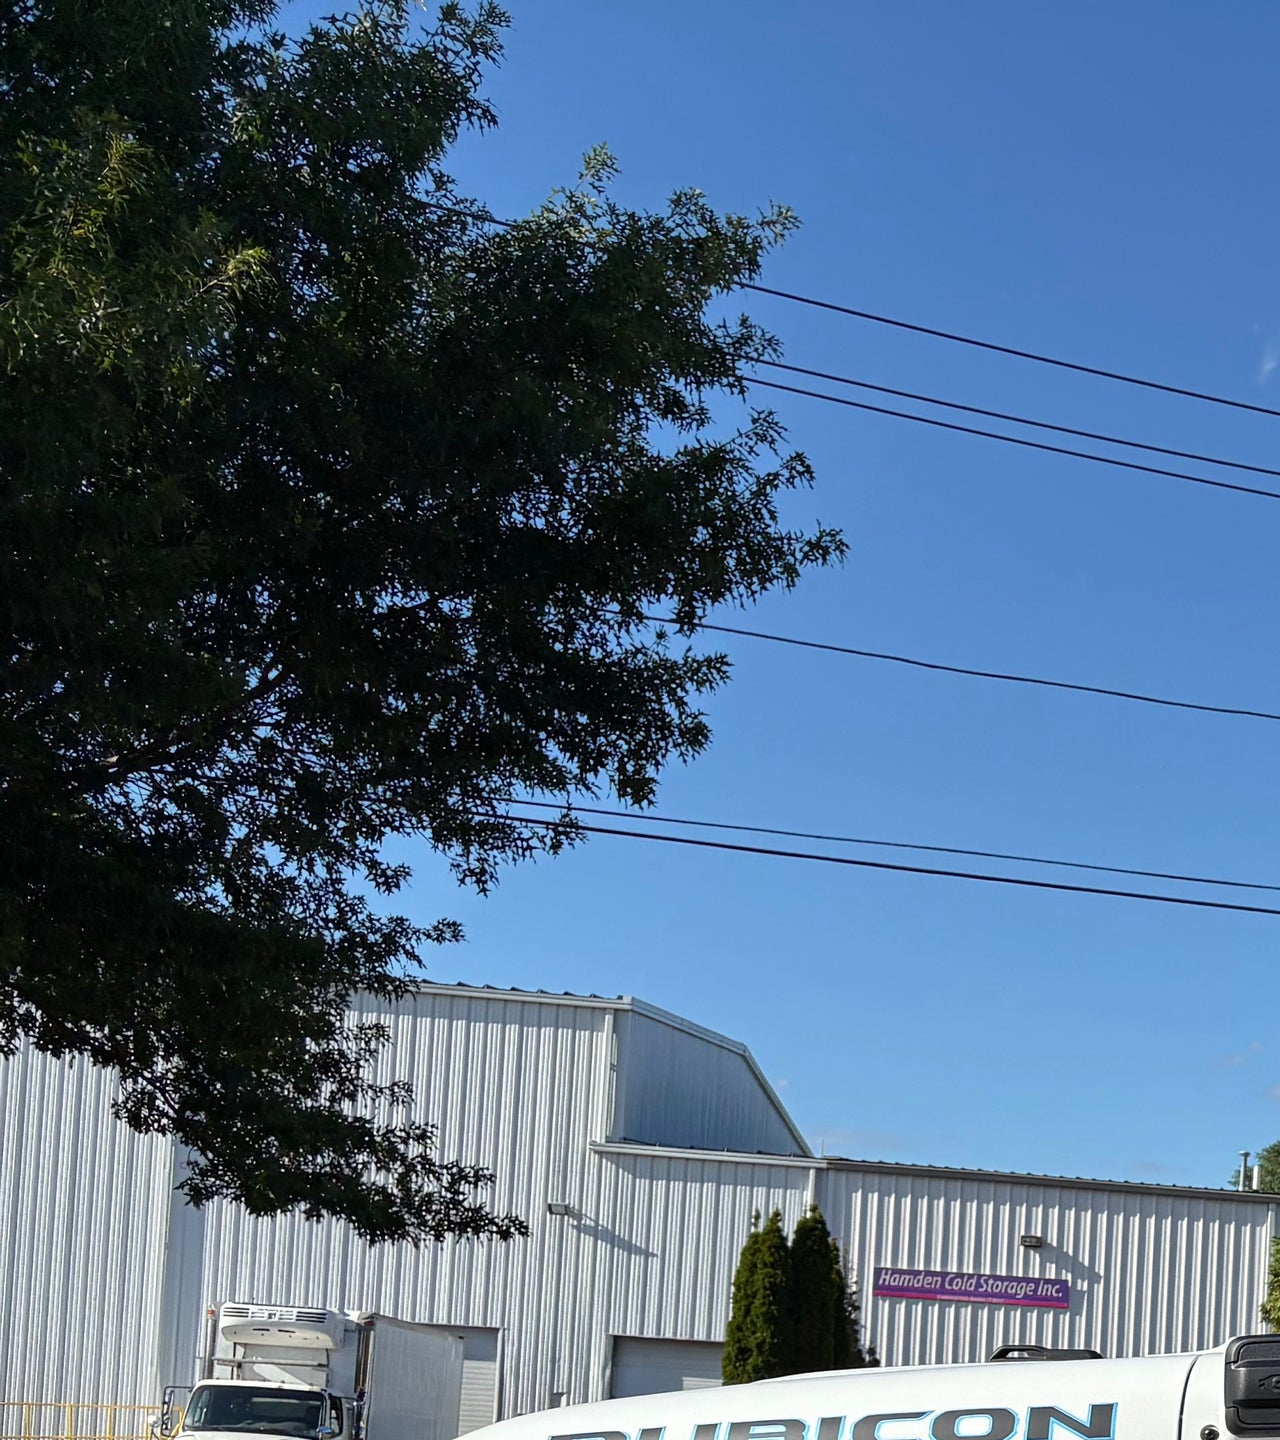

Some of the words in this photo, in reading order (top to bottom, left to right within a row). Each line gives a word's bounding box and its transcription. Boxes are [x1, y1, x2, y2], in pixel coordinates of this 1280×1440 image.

[878, 1269, 941, 1289] Hamden
[945, 1273, 977, 1291] Cold
[979, 1276, 1035, 1299] Storage
[1037, 1280, 1063, 1298] Inc.
